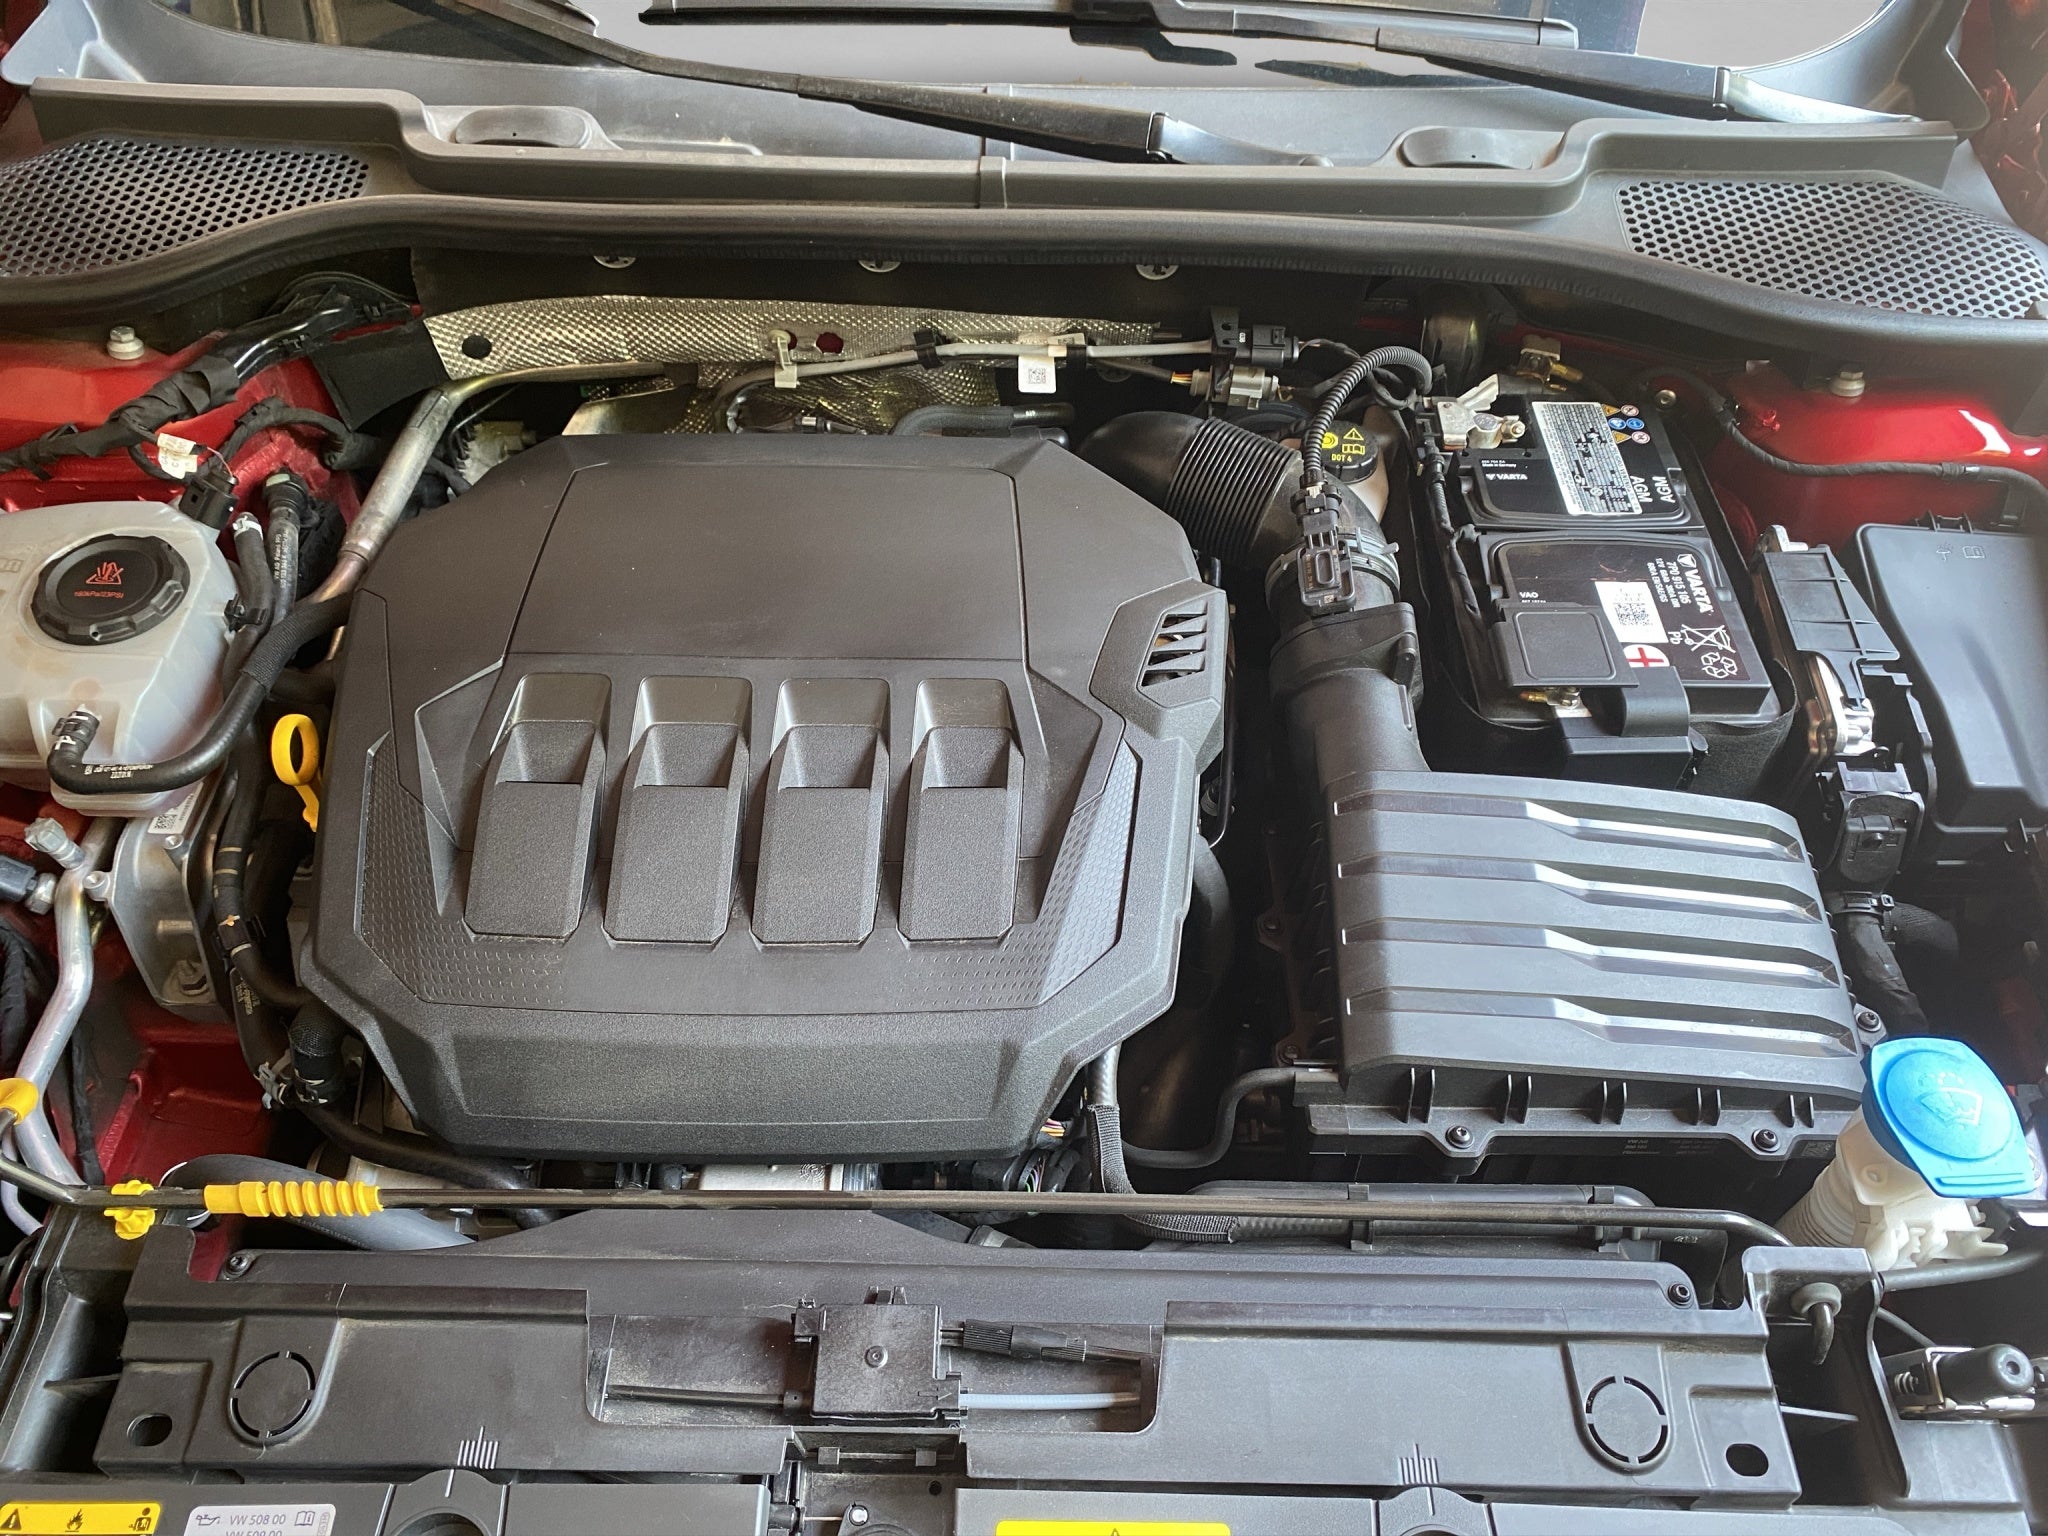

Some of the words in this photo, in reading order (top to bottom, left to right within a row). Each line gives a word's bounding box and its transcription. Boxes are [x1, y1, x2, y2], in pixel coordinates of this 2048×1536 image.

[1331, 453, 1346, 462] DOT
[1347, 455, 1353, 463] 4
[1630, 475, 1653, 502] AGM
[1652, 476, 1676, 503] AGM
[1672, 576, 1686, 589] 915
[1685, 569, 1714, 613] VARTA
[1668, 631, 1682, 645] Pb
[230, 1514, 248, 1525] VW
[249, 1514, 270, 1525] 508
[272, 1514, 286, 1525] 00
